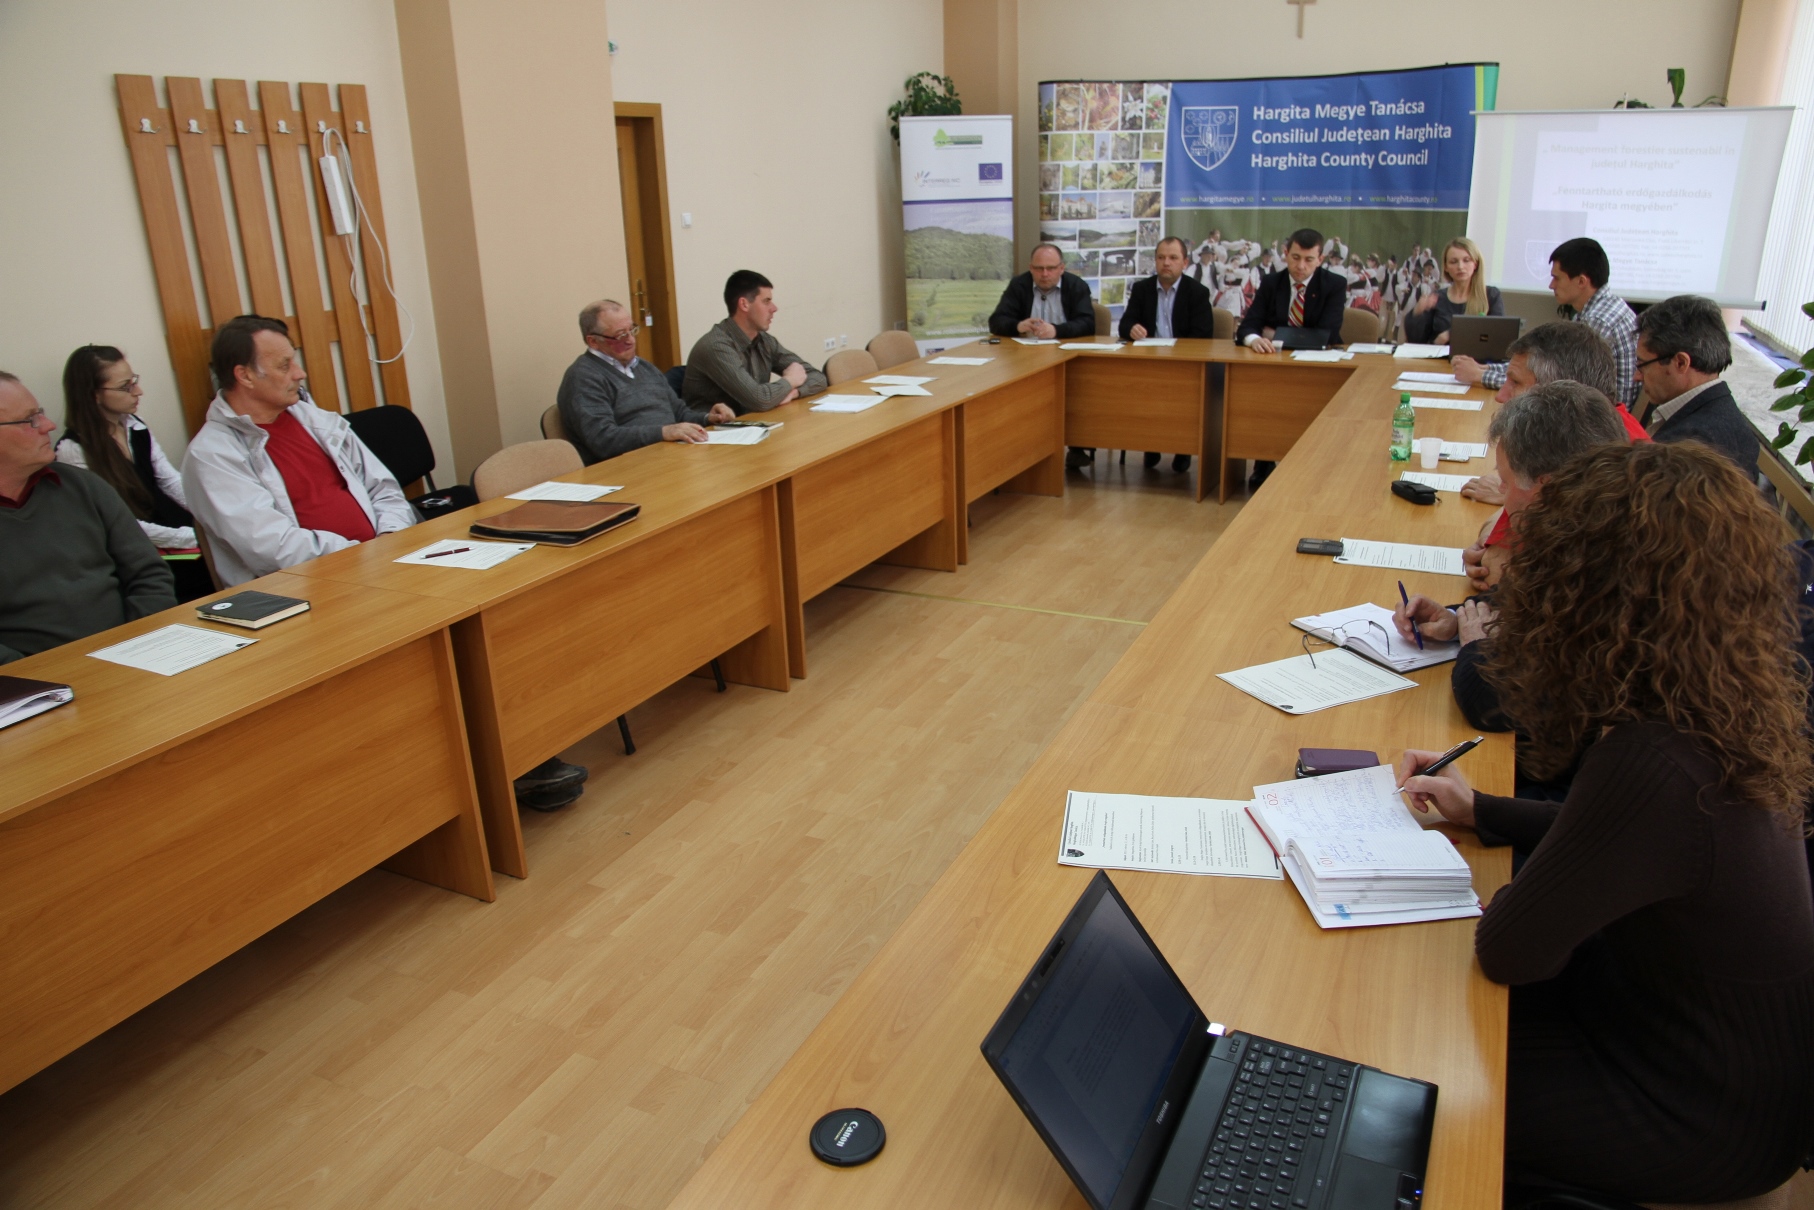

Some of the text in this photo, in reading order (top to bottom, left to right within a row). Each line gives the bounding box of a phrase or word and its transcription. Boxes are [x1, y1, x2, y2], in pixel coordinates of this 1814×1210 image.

[1252, 99, 1425, 123] Hargita Megye Tanácsa
[1251, 127, 1319, 145] Consiliul
[1394, 122, 1452, 143] Harghita
[1251, 149, 1428, 171] Harghita County Council
[1156, 1100, 1170, 1125] TOSHIBA
[836, 1120, 859, 1148] Canon
